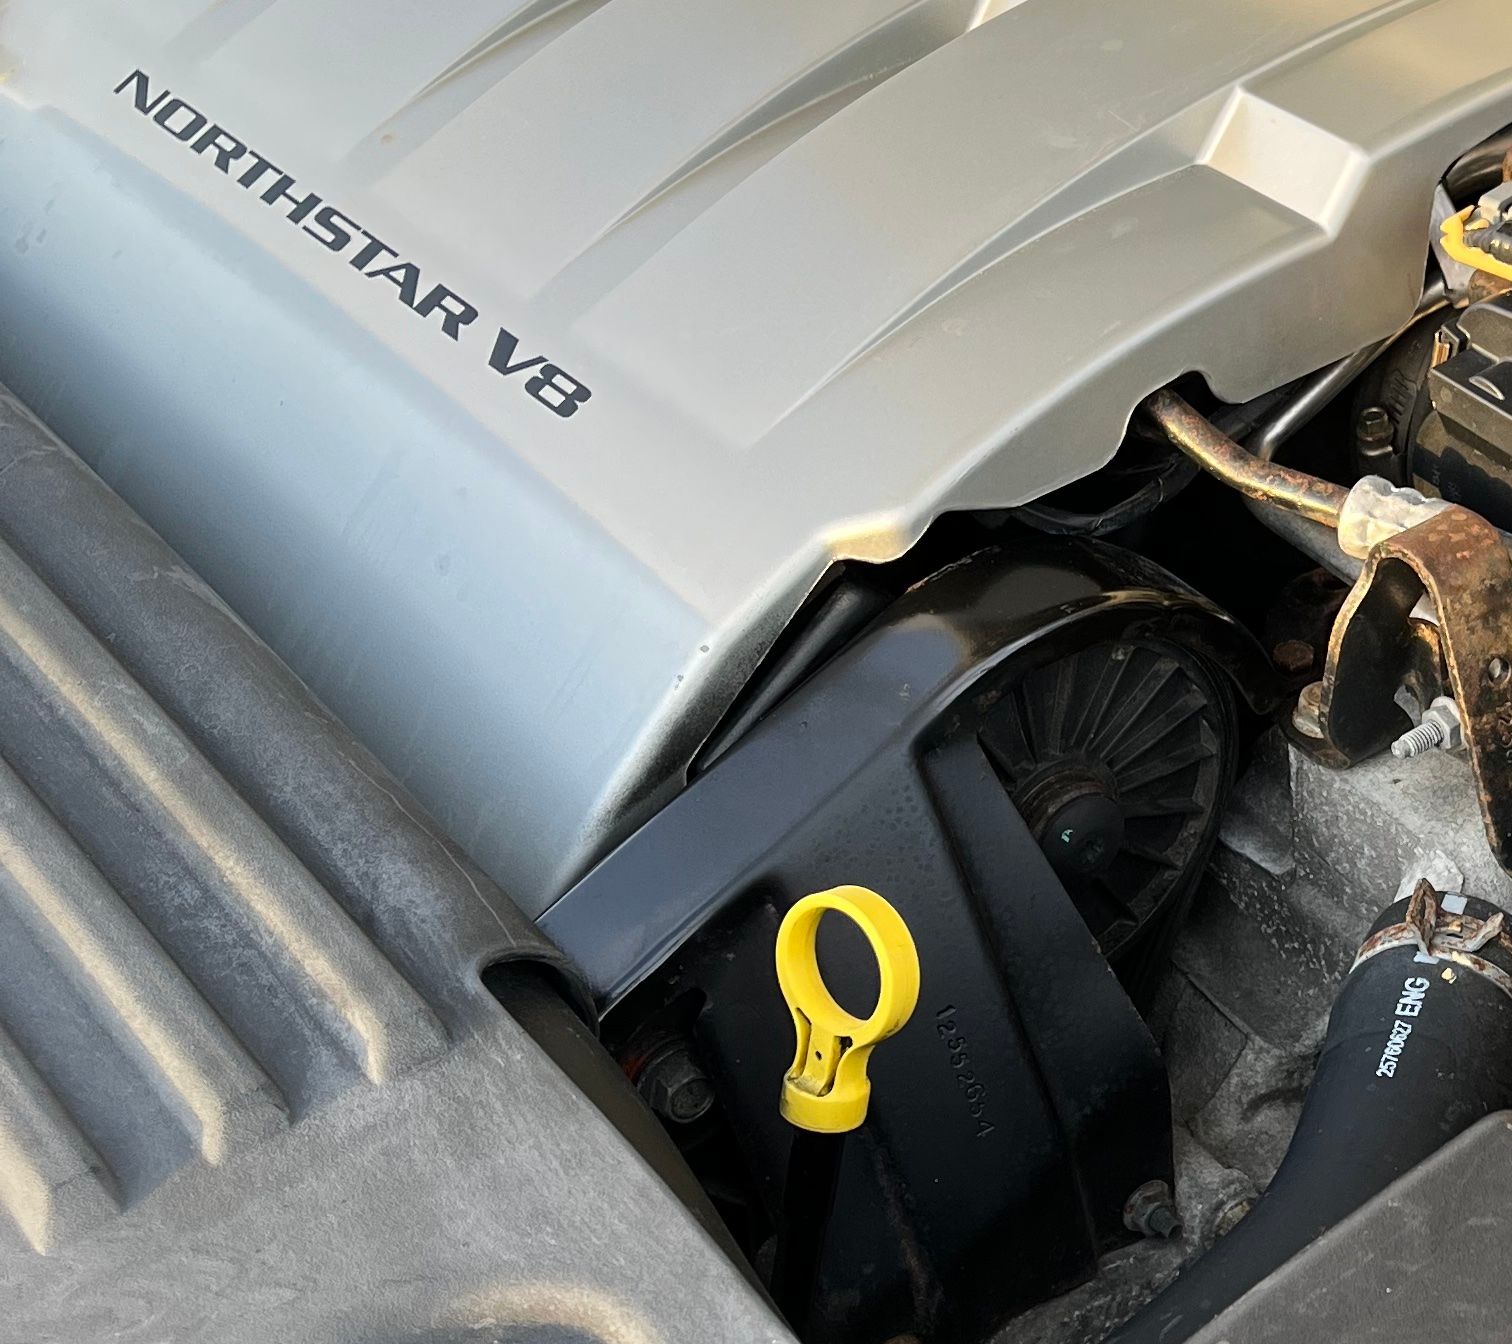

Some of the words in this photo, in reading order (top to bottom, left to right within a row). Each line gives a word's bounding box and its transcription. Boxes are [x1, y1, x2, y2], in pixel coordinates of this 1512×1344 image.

[113, 69, 479, 342] NORTHSTAR
[488, 327, 592, 418] V8
[1394, 976, 1431, 1017] ENG
